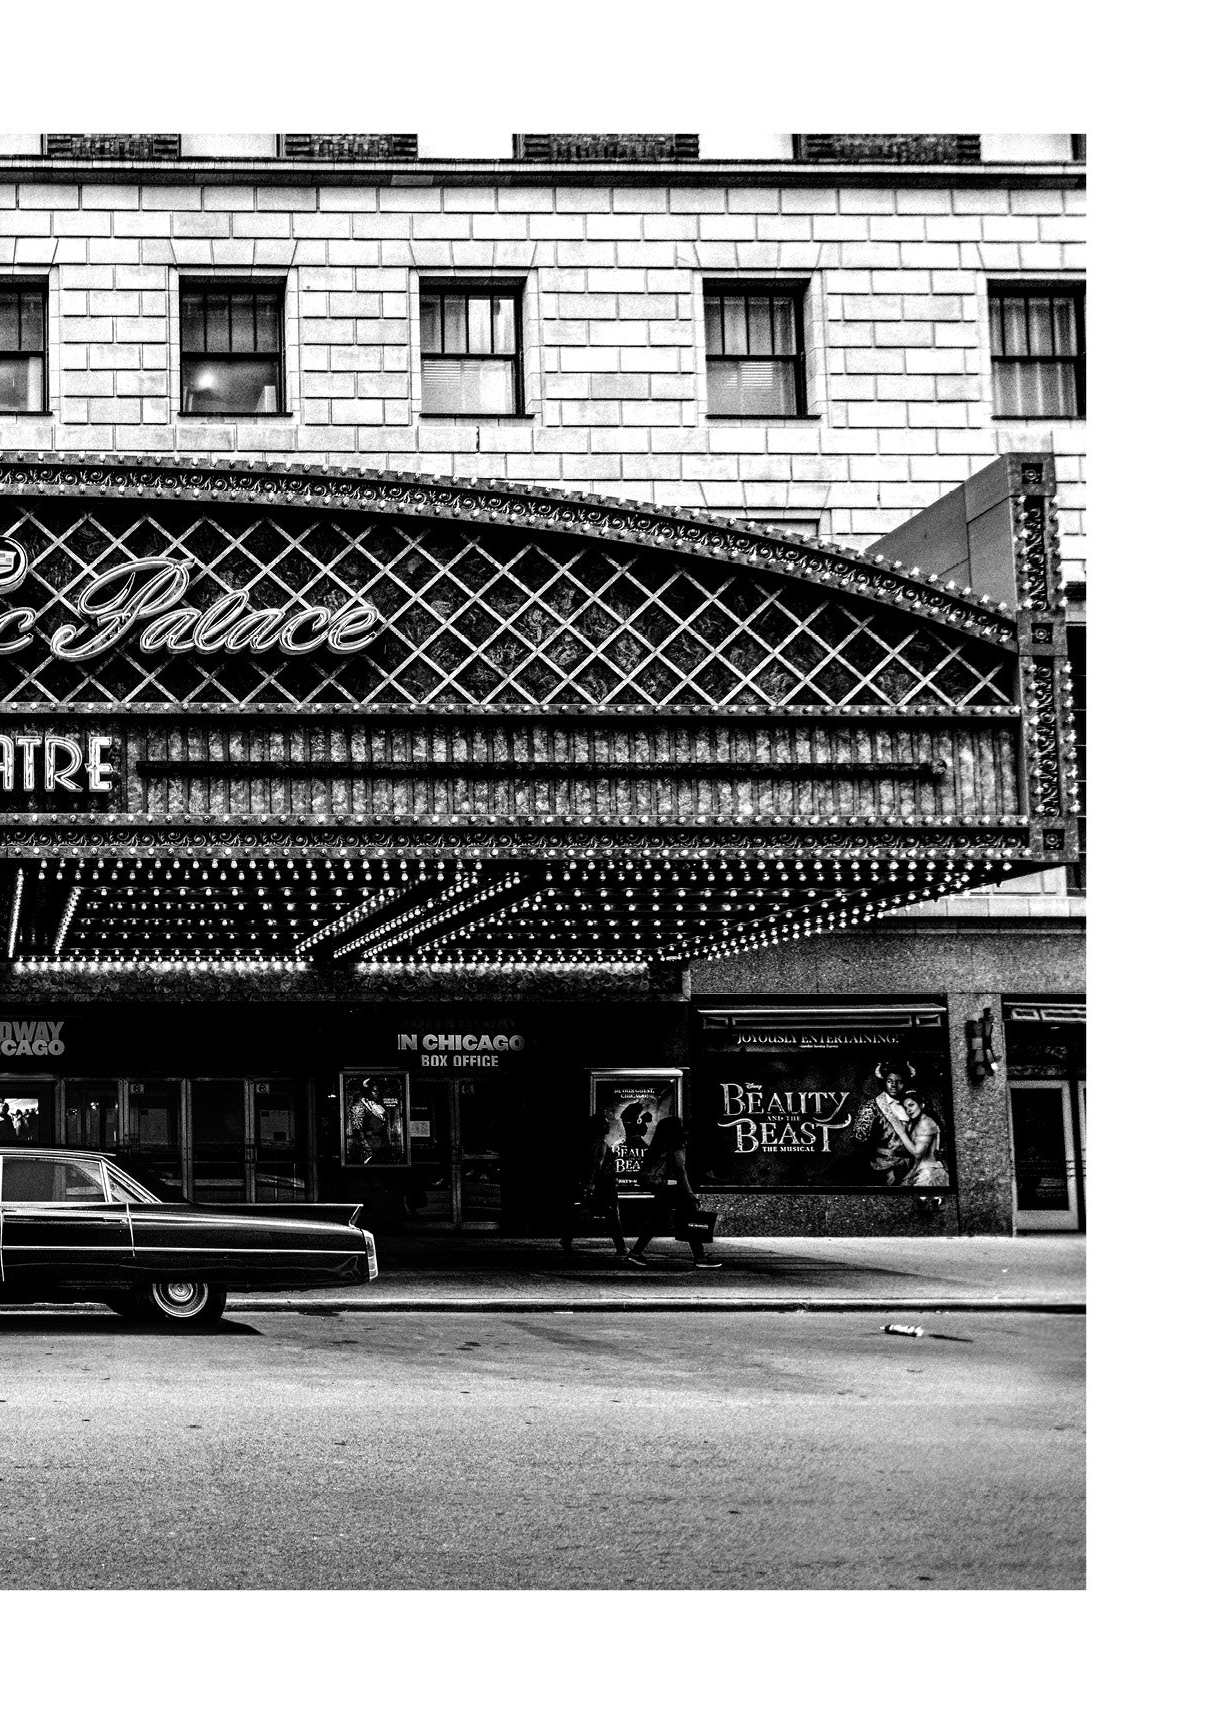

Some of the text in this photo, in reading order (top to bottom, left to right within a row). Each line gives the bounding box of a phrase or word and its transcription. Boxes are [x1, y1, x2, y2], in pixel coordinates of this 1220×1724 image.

[50, 557, 380, 661] Palace
[397, 1034, 525, 1051] IN CHICAGO
[421, 1055, 499, 1067] BOX OFFICE
[720, 1083, 850, 1122] BEAUTY
[717, 1118, 852, 1153] BEAST
[615, 1158, 644, 1173] BEA
